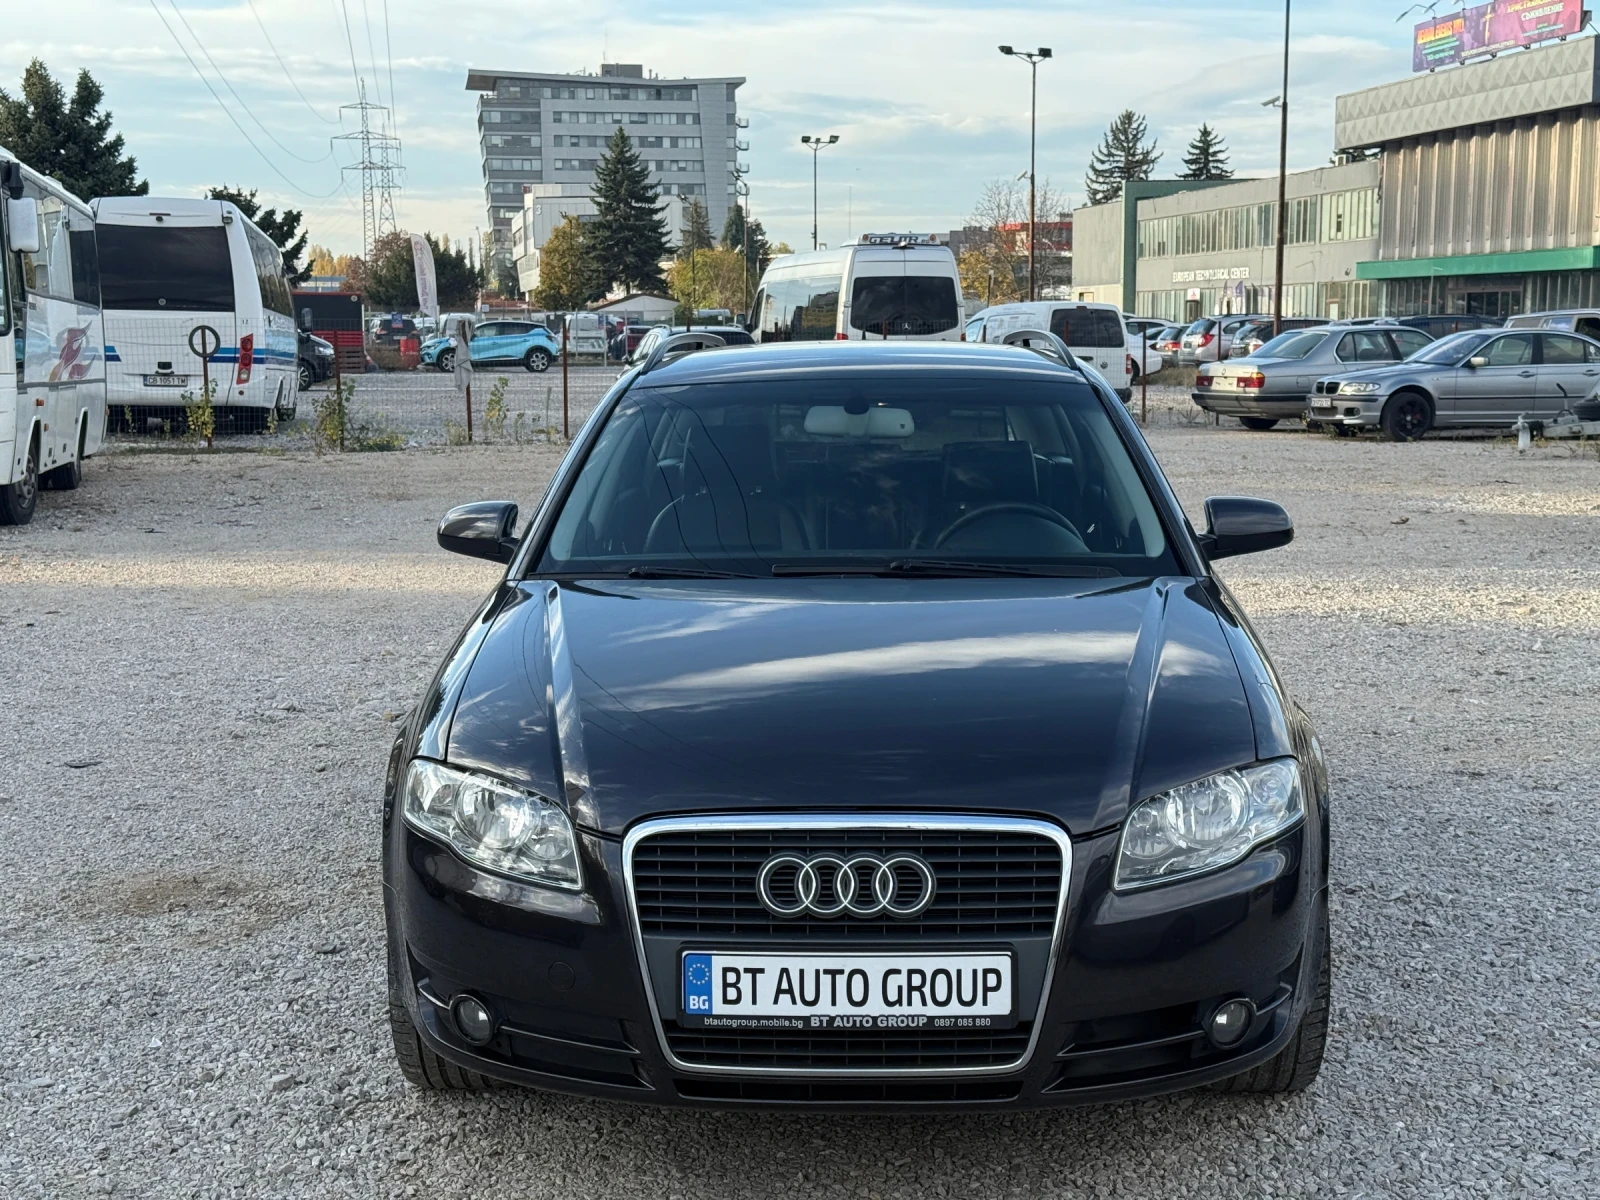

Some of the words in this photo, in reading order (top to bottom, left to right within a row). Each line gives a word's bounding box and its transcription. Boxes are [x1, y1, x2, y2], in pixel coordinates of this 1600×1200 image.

[1230, 267, 1250, 279] CENTER
[160, 377, 175, 385] 1051
[722, 967, 766, 1006] BT
[773, 967, 869, 1007] AUTO
[881, 967, 1003, 1007] GROUP
[689, 995, 709, 1010] BG
[704, 1017, 804, 1028] btautogroup.mobile.bg
[810, 1016, 830, 1027] BT
[834, 1016, 873, 1027] AUTO
[877, 1016, 928, 1027] GROUP
[934, 1018, 954, 1027] 0897
[957, 1018, 973, 1026] 085
[975, 1018, 991, 1026] 880
